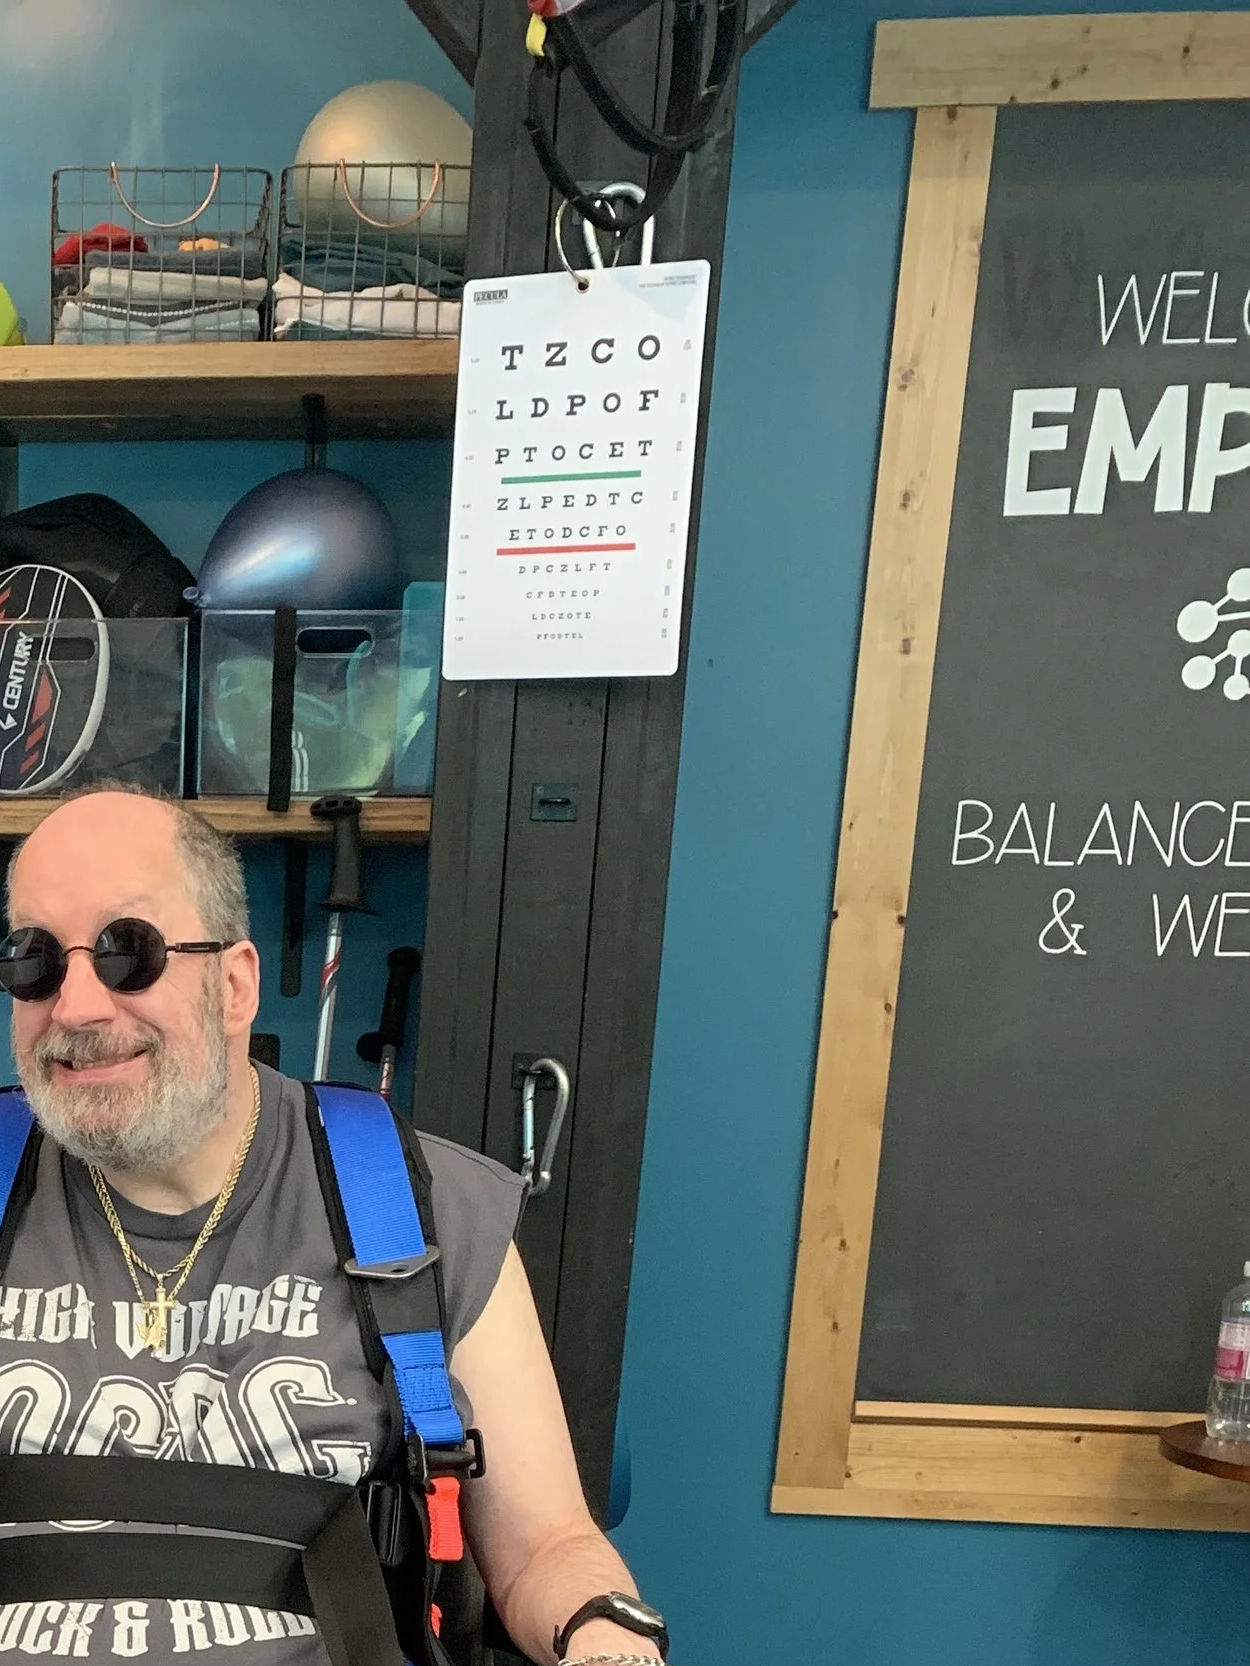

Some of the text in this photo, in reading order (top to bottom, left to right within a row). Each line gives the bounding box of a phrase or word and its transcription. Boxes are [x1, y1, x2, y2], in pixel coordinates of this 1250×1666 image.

[1098, 271, 1250, 345] WEL
[1003, 382, 1250, 516] EMP
[4, 631, 34, 711] CENTURY
[952, 800, 1250, 867] BALANCE
[1038, 888, 1250, 957] & WE
[111, 1600, 150, 1657] &
